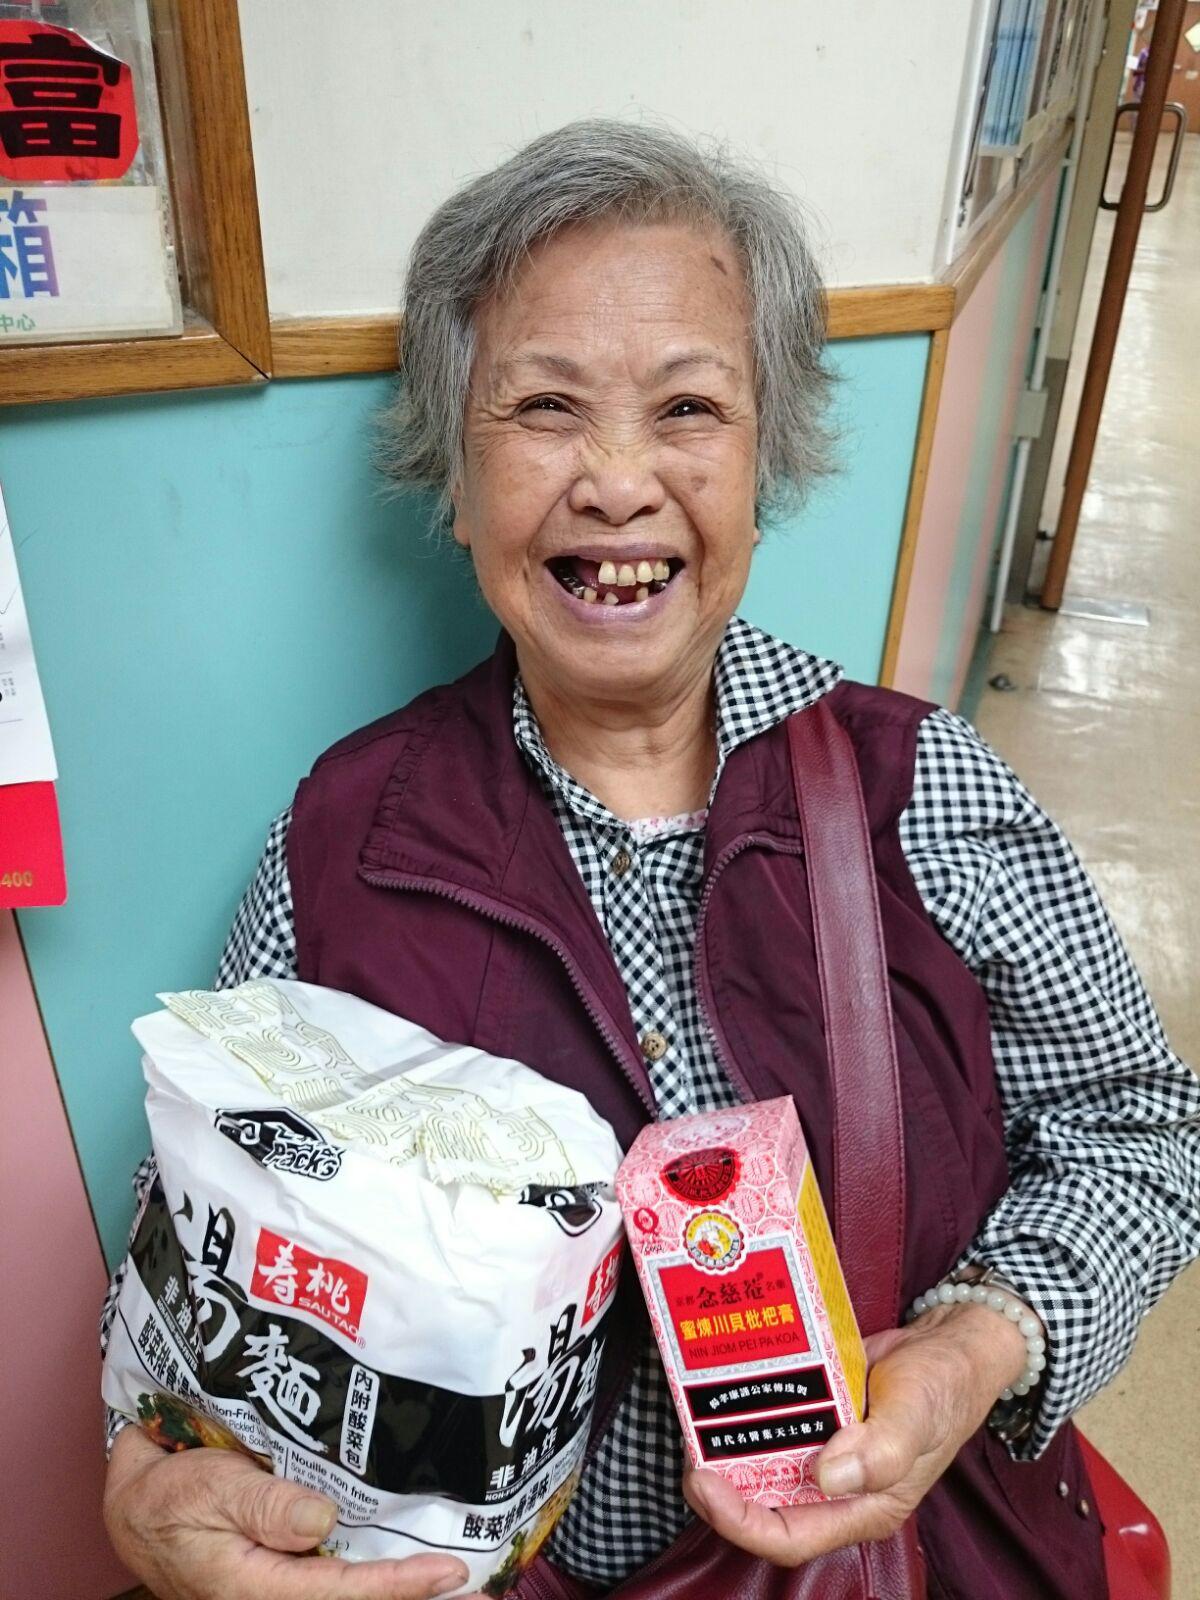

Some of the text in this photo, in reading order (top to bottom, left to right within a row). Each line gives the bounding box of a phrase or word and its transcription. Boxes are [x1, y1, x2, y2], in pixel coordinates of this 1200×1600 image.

[0, 34, 122, 159] 富
[689, 1332, 800, 1359] NIN JIOM PEI PA KOA
[291, 1451, 327, 1476] Nouille
[330, 1472, 348, 1491] non
[351, 1486, 379, 1505] frites
